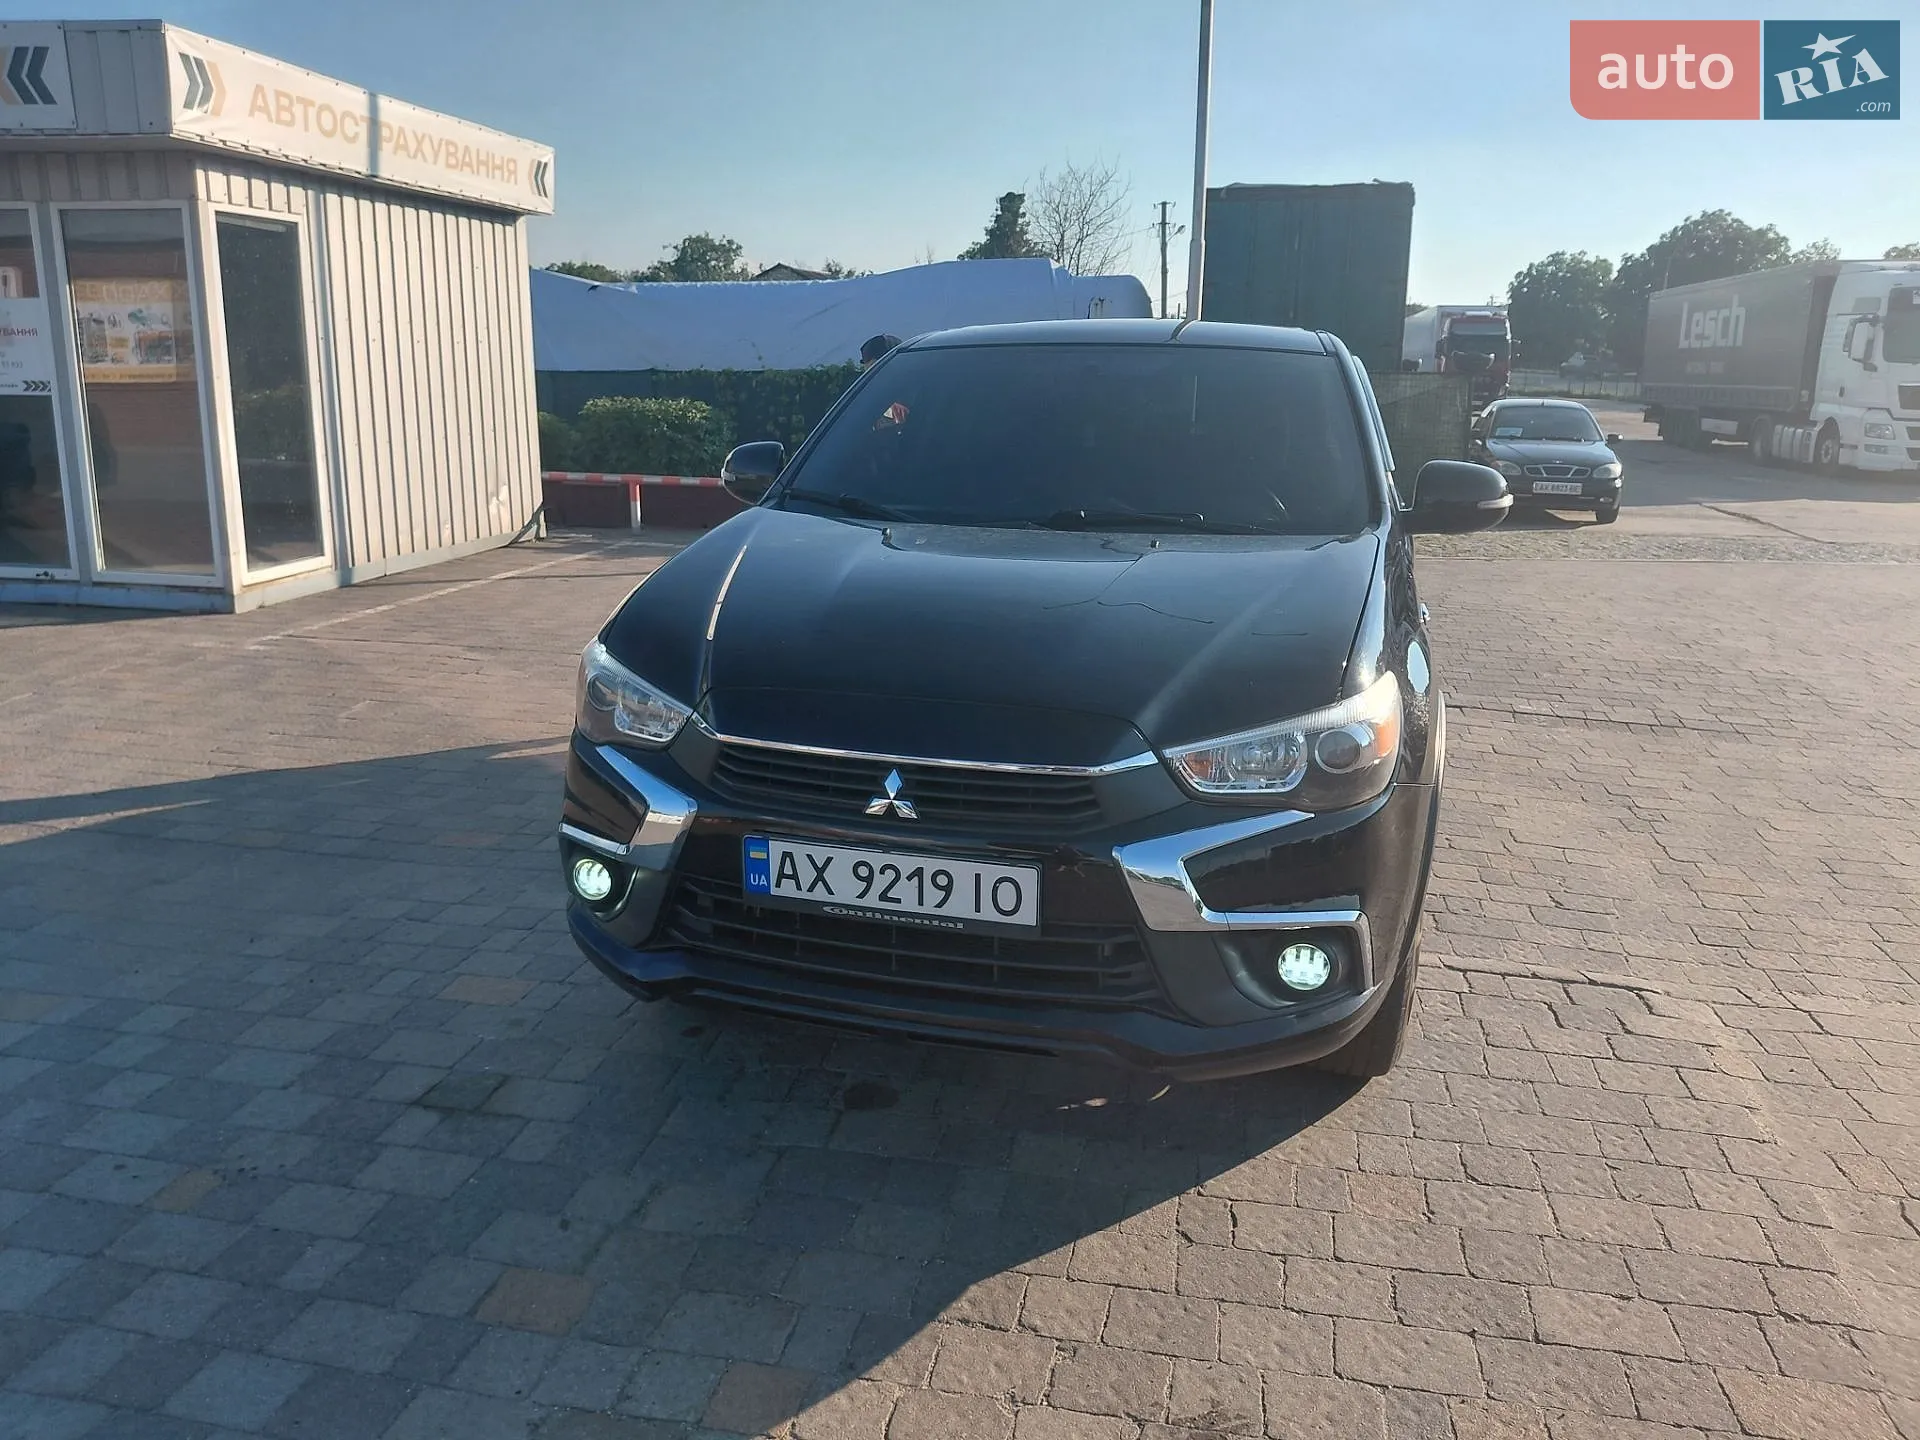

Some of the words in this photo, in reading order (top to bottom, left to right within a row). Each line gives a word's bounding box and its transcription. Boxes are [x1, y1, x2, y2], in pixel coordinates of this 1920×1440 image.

[247, 83, 520, 186] АВТОСТРАХУВАННЯ
[1678, 293, 1747, 349] Lesch
[750, 872, 768, 887] UA
[774, 850, 836, 896] AX
[851, 859, 955, 909] 9219
[822, 905, 965, 929] Continental
